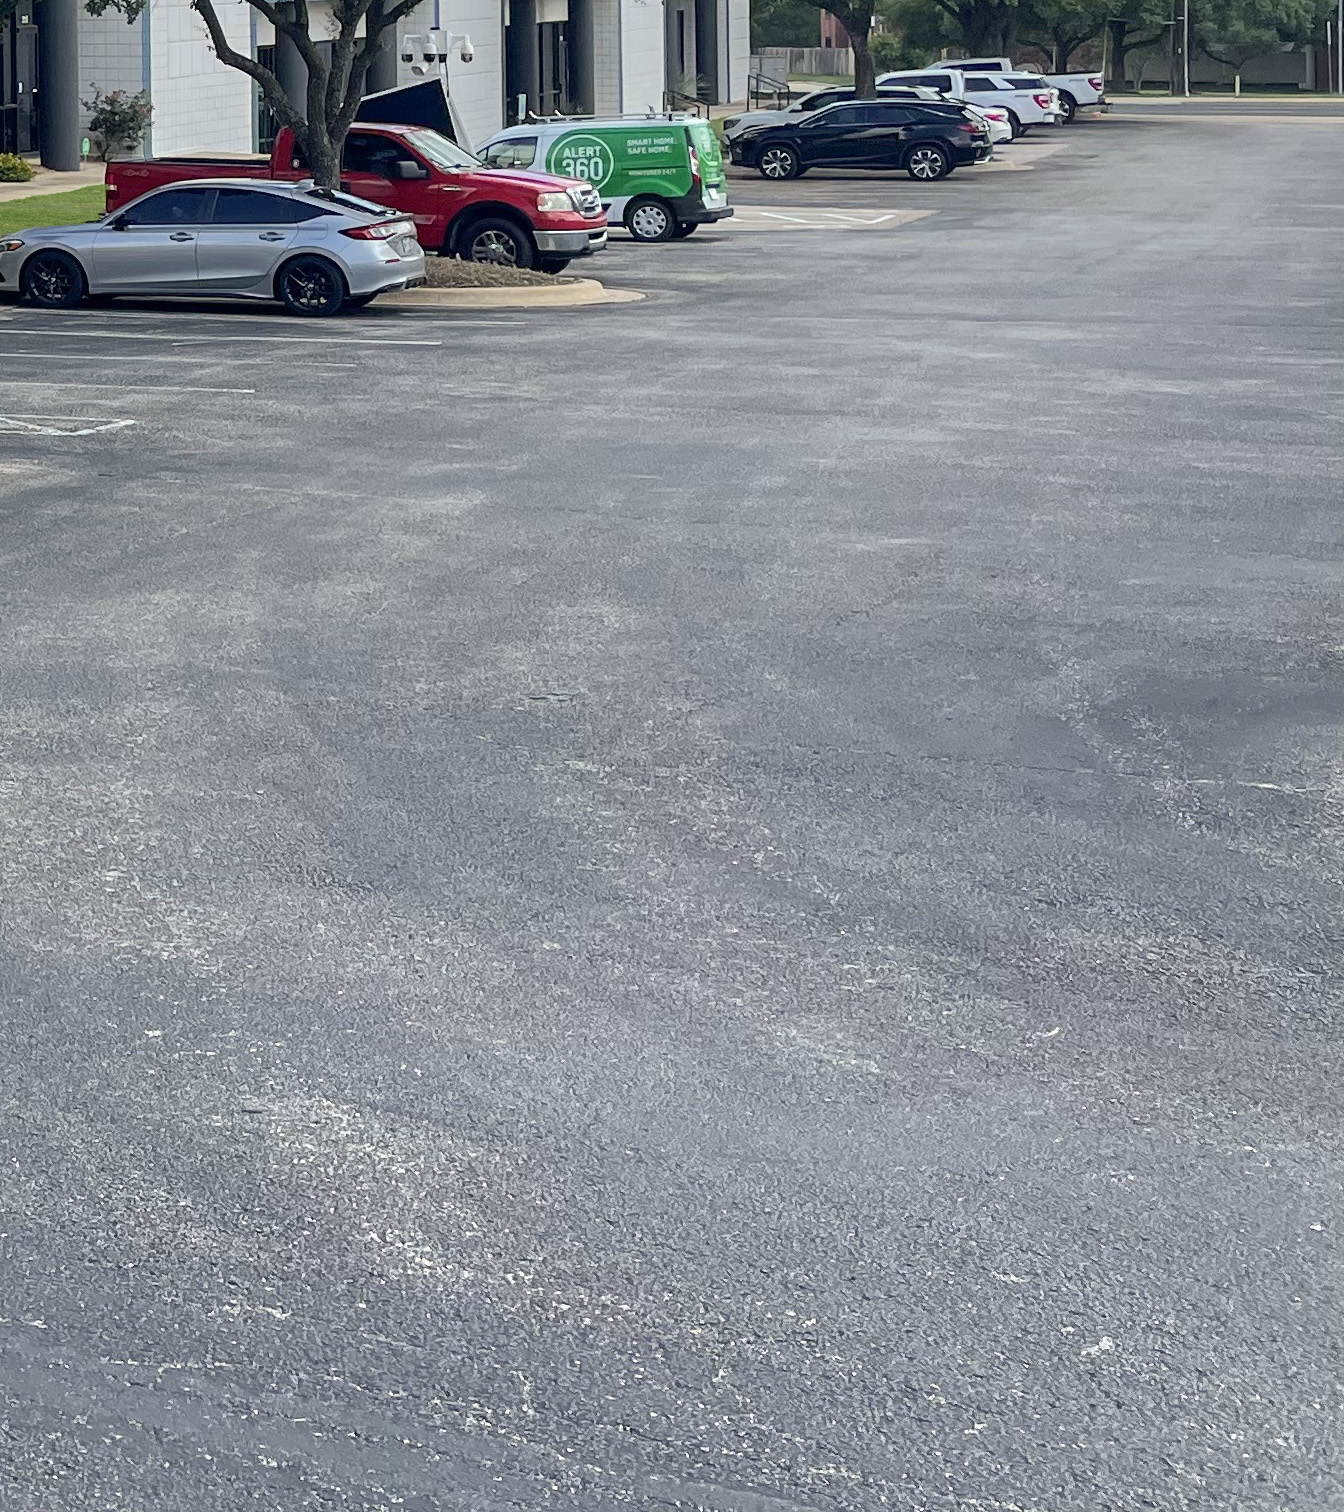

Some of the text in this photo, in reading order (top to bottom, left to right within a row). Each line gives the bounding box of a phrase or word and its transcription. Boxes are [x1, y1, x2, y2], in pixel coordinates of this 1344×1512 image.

[627, 138, 652, 146] SMART
[563, 146, 601, 158] ALERT
[562, 157, 603, 180] 360
